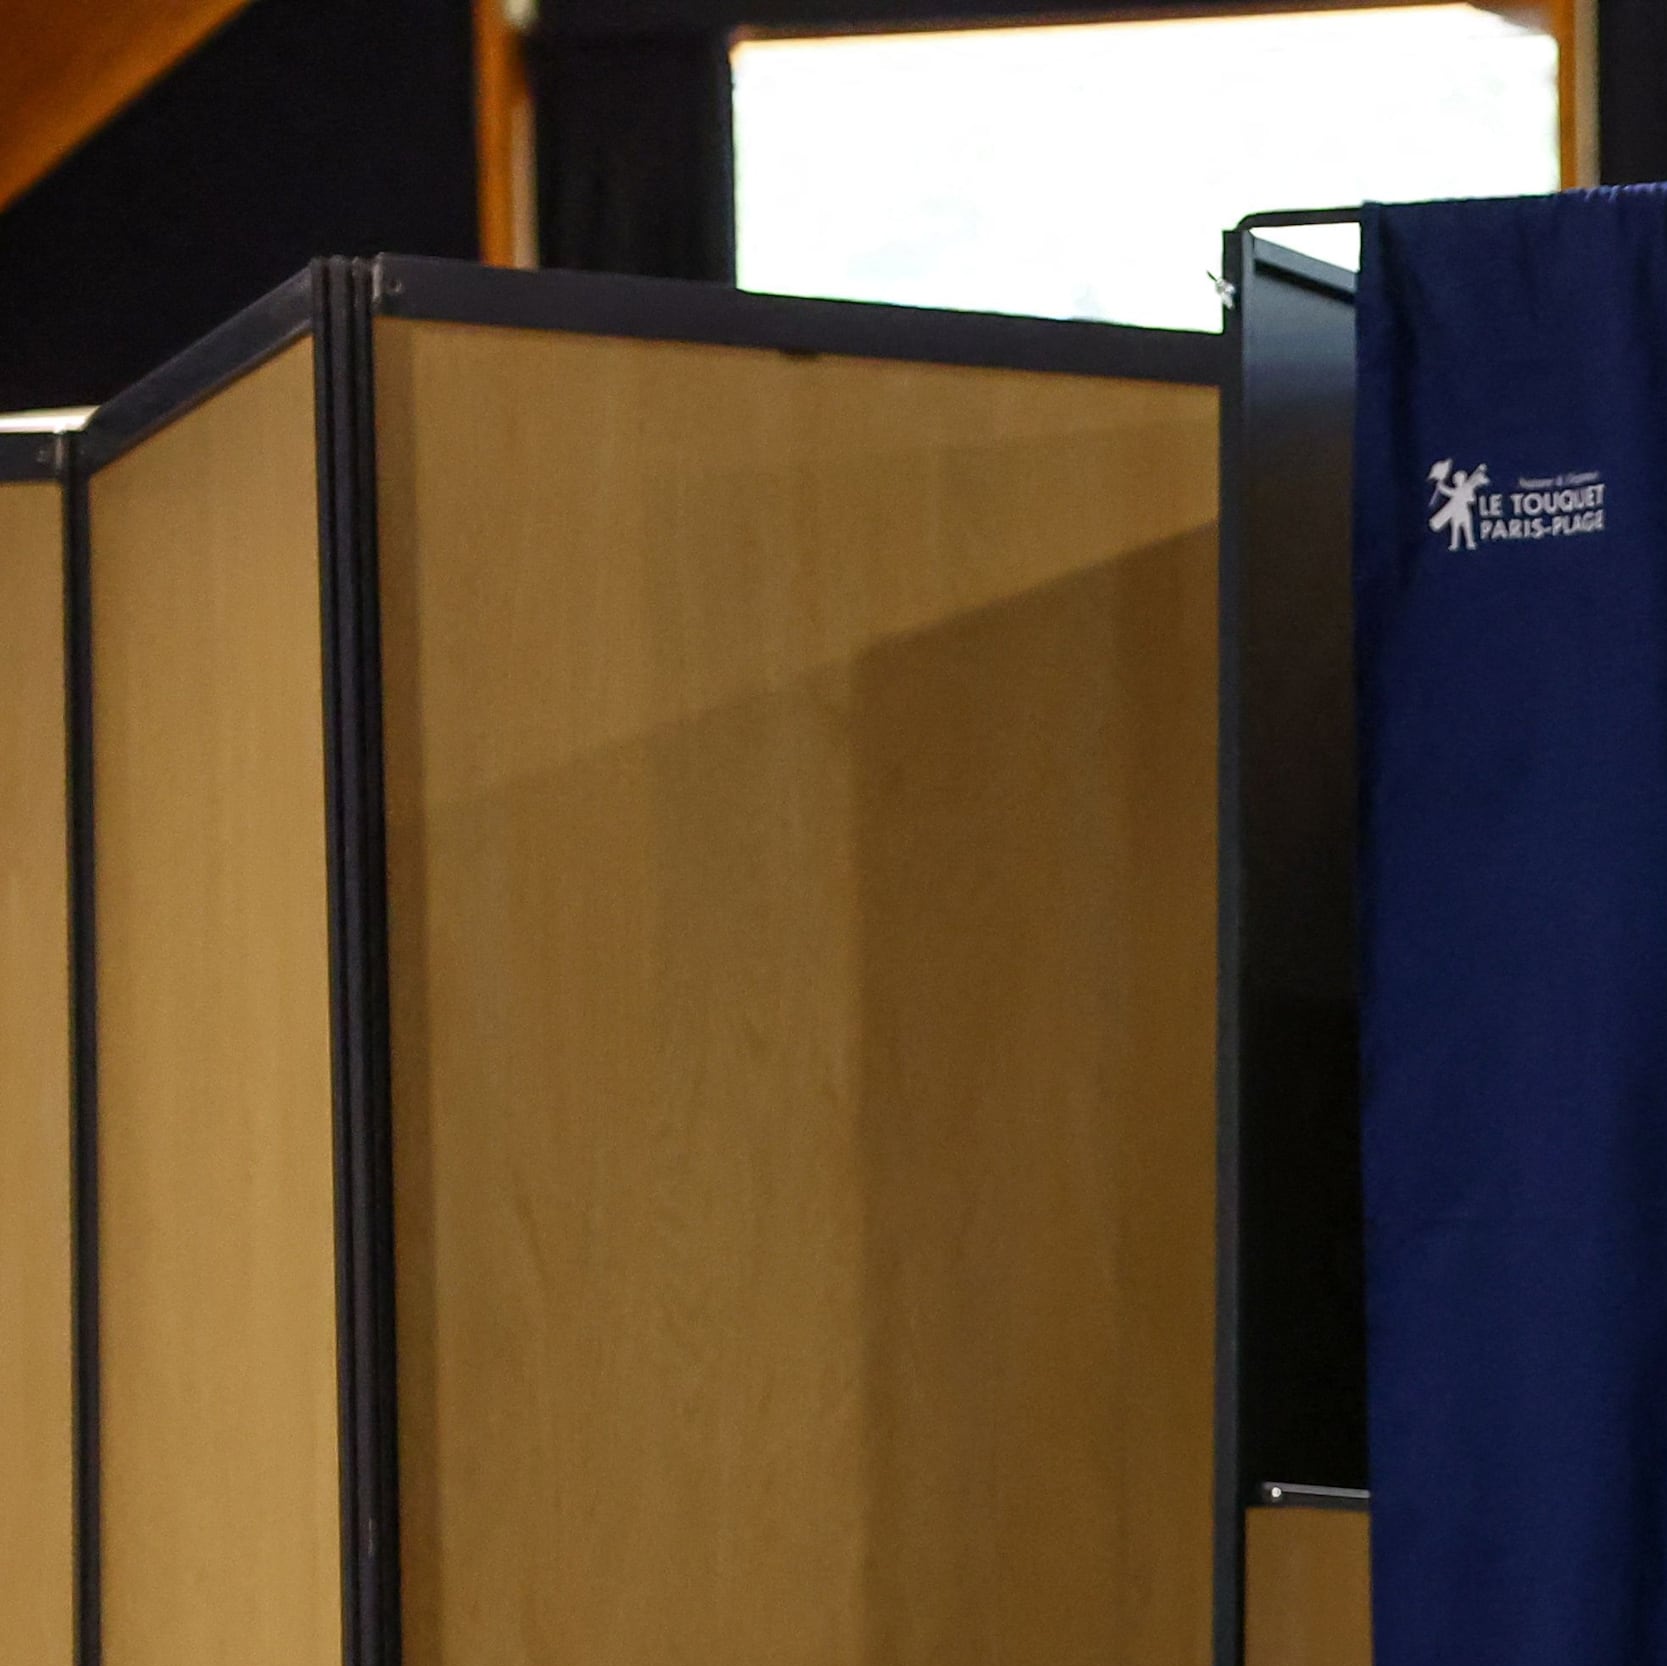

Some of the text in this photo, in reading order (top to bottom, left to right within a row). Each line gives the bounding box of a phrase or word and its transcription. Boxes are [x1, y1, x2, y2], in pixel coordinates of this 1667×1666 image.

[1479, 484, 1605, 516] LE TOUQUET
[1480, 509, 1604, 539] PARIS-PLAGE
